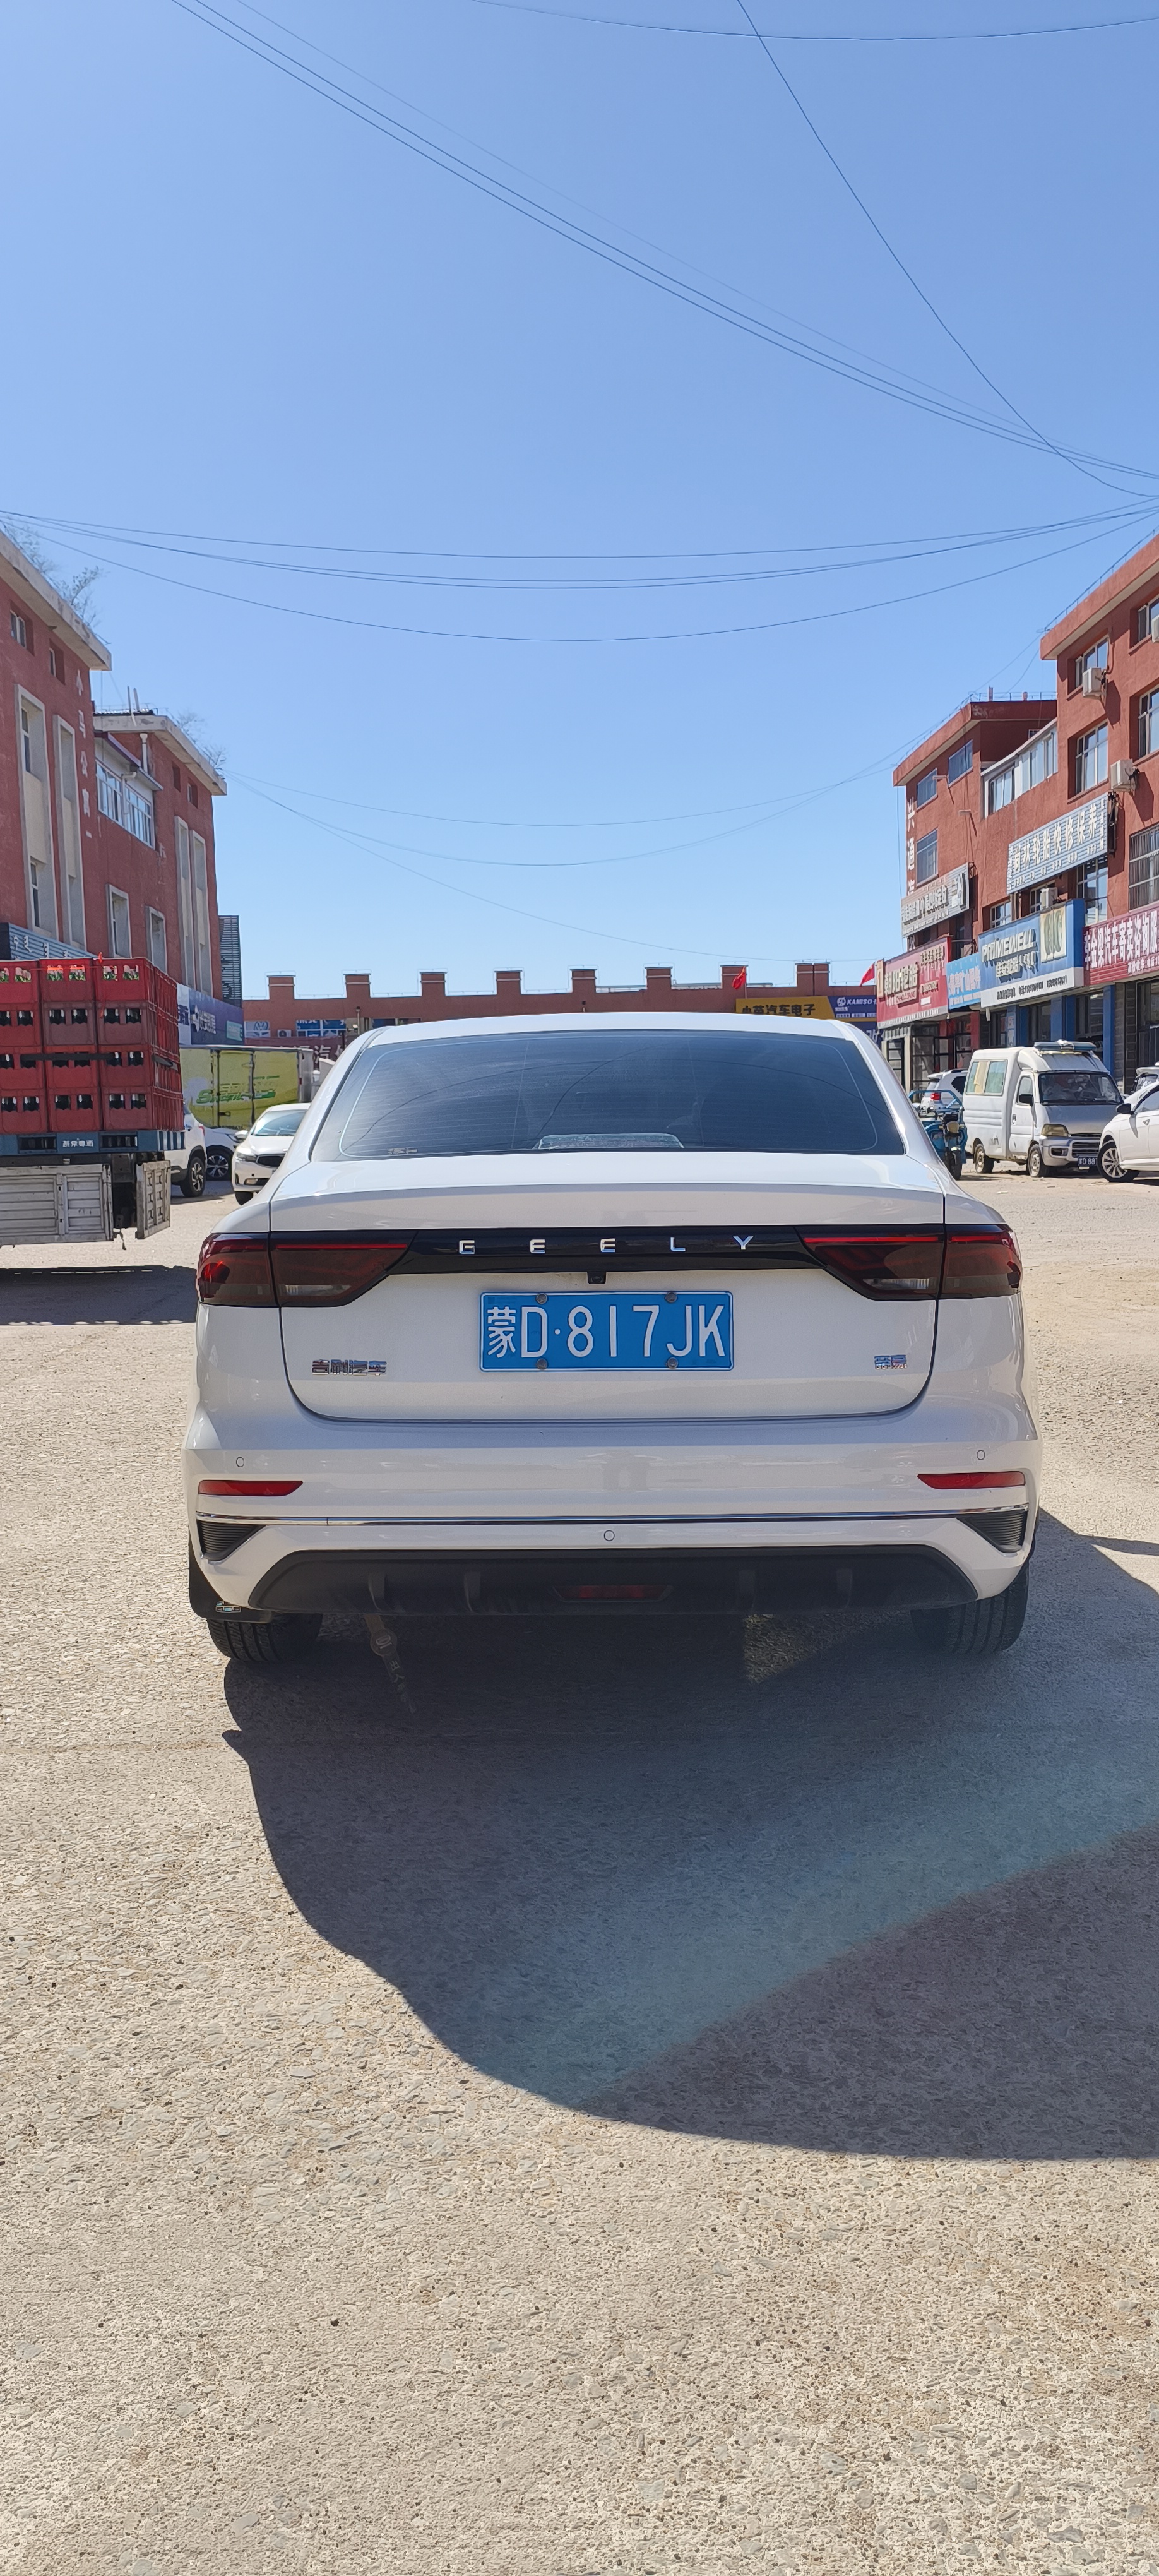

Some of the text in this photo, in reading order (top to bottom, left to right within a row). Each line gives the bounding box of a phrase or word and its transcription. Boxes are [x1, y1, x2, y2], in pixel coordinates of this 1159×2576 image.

[982, 928, 1037, 963] PRIMEWELL
[459, 1236, 754, 1255] GEELY
[312, 1359, 387, 1376] 吉利汽车
